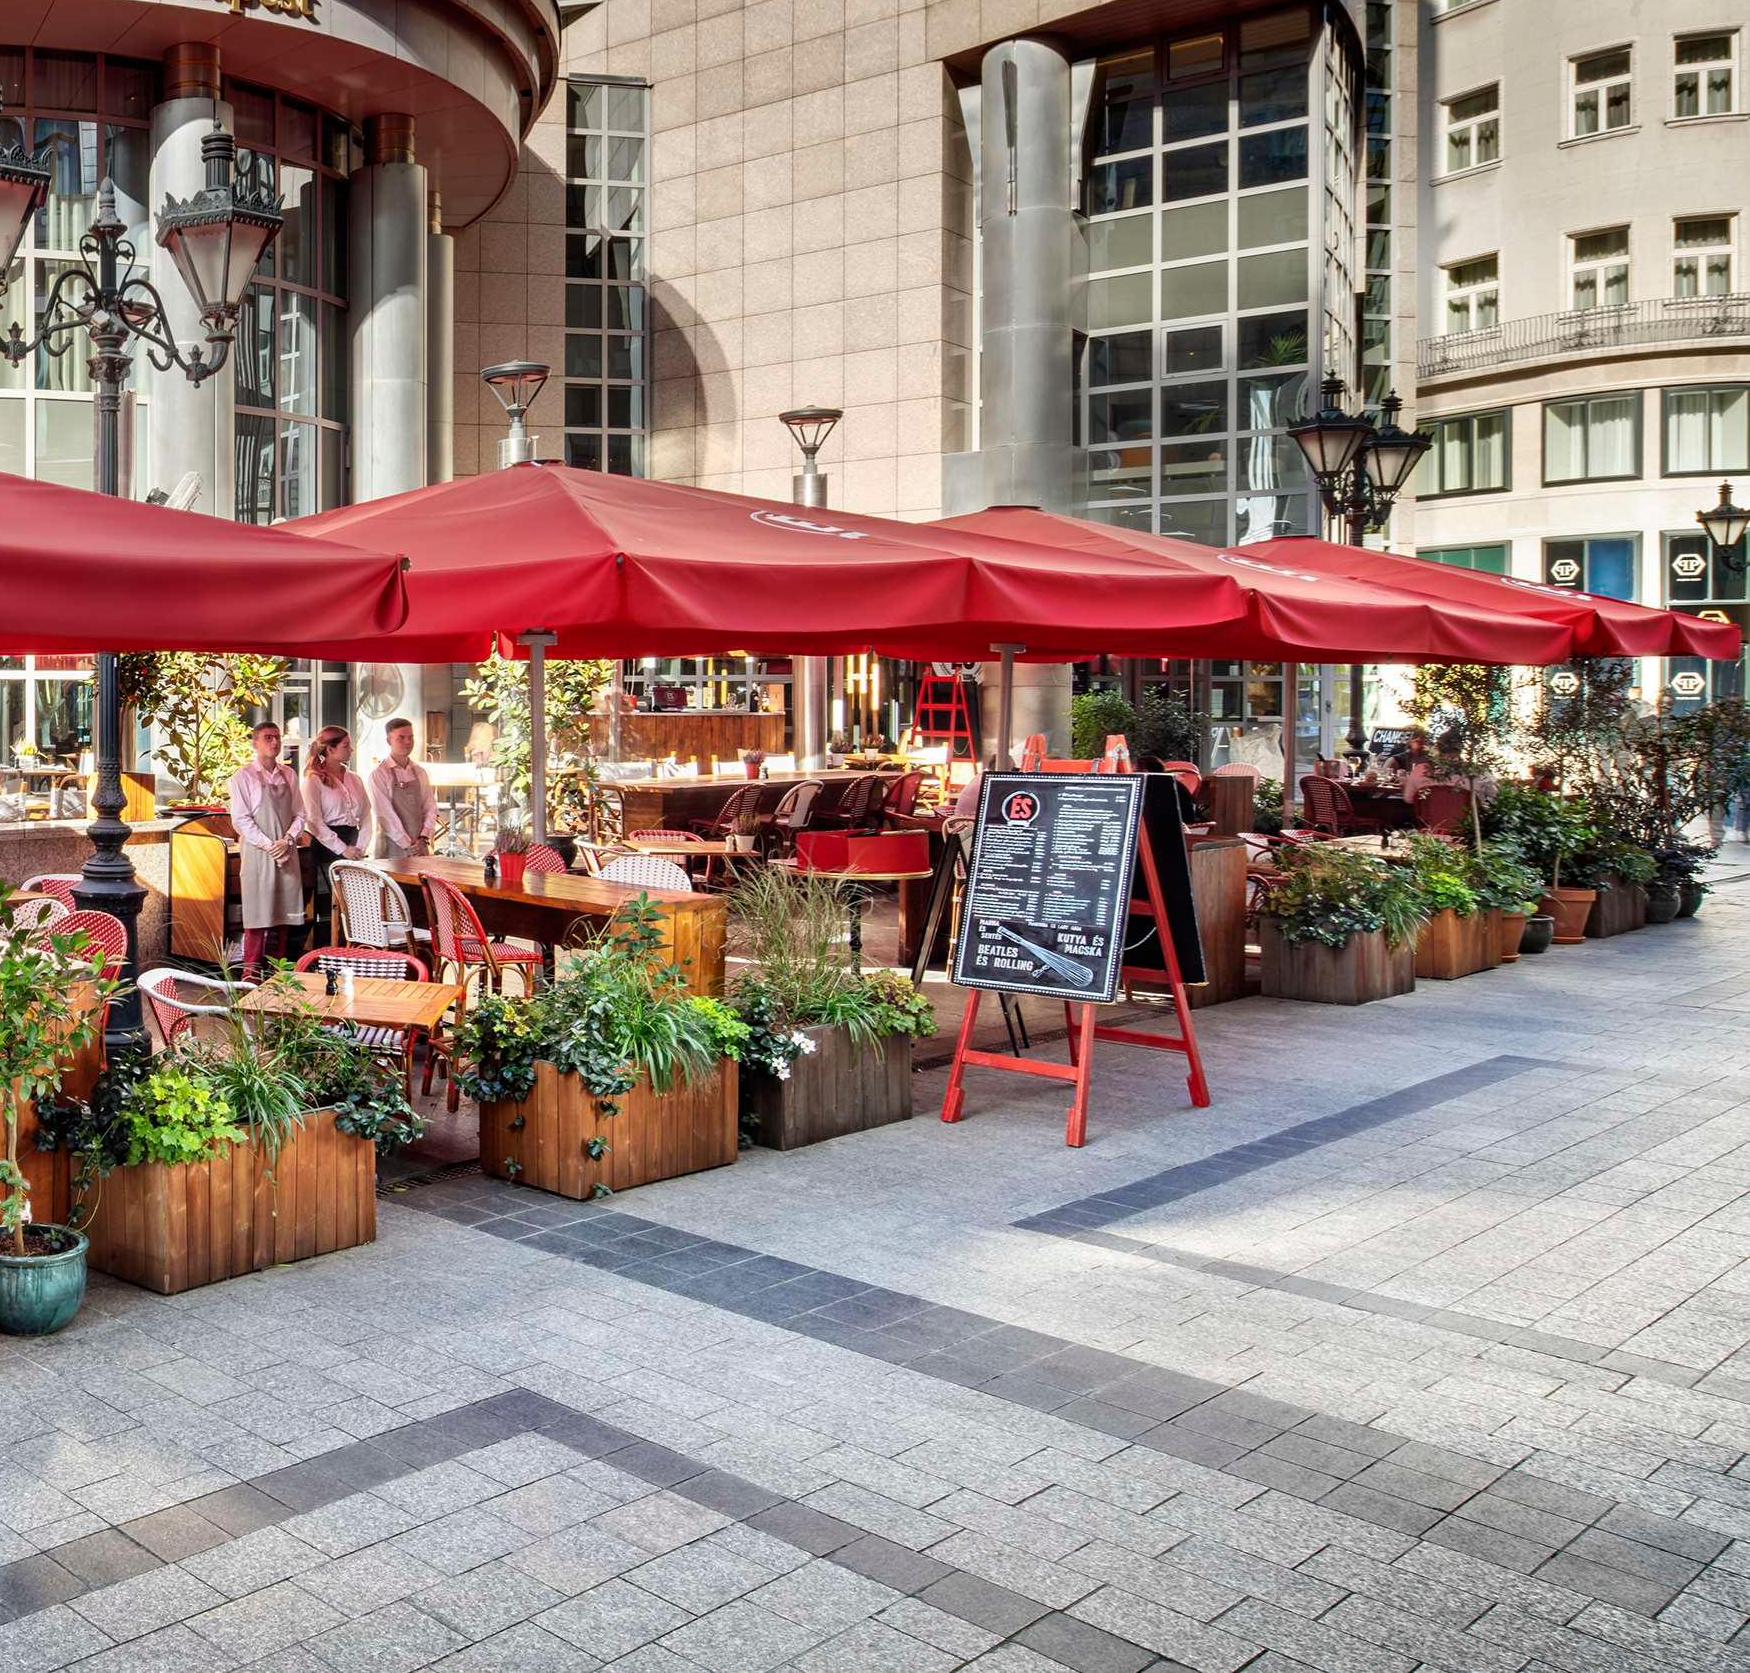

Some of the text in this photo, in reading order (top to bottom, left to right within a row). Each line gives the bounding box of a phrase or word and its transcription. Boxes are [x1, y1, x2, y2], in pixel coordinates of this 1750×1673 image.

[1010, 795, 1033, 820] ÉS
[1057, 932, 1105, 947] KUTYA ÉS
[978, 944, 1019, 958] BEATLES
[1064, 944, 1102, 958] MACSKA
[976, 954, 1034, 971] ÉS ROLLING
